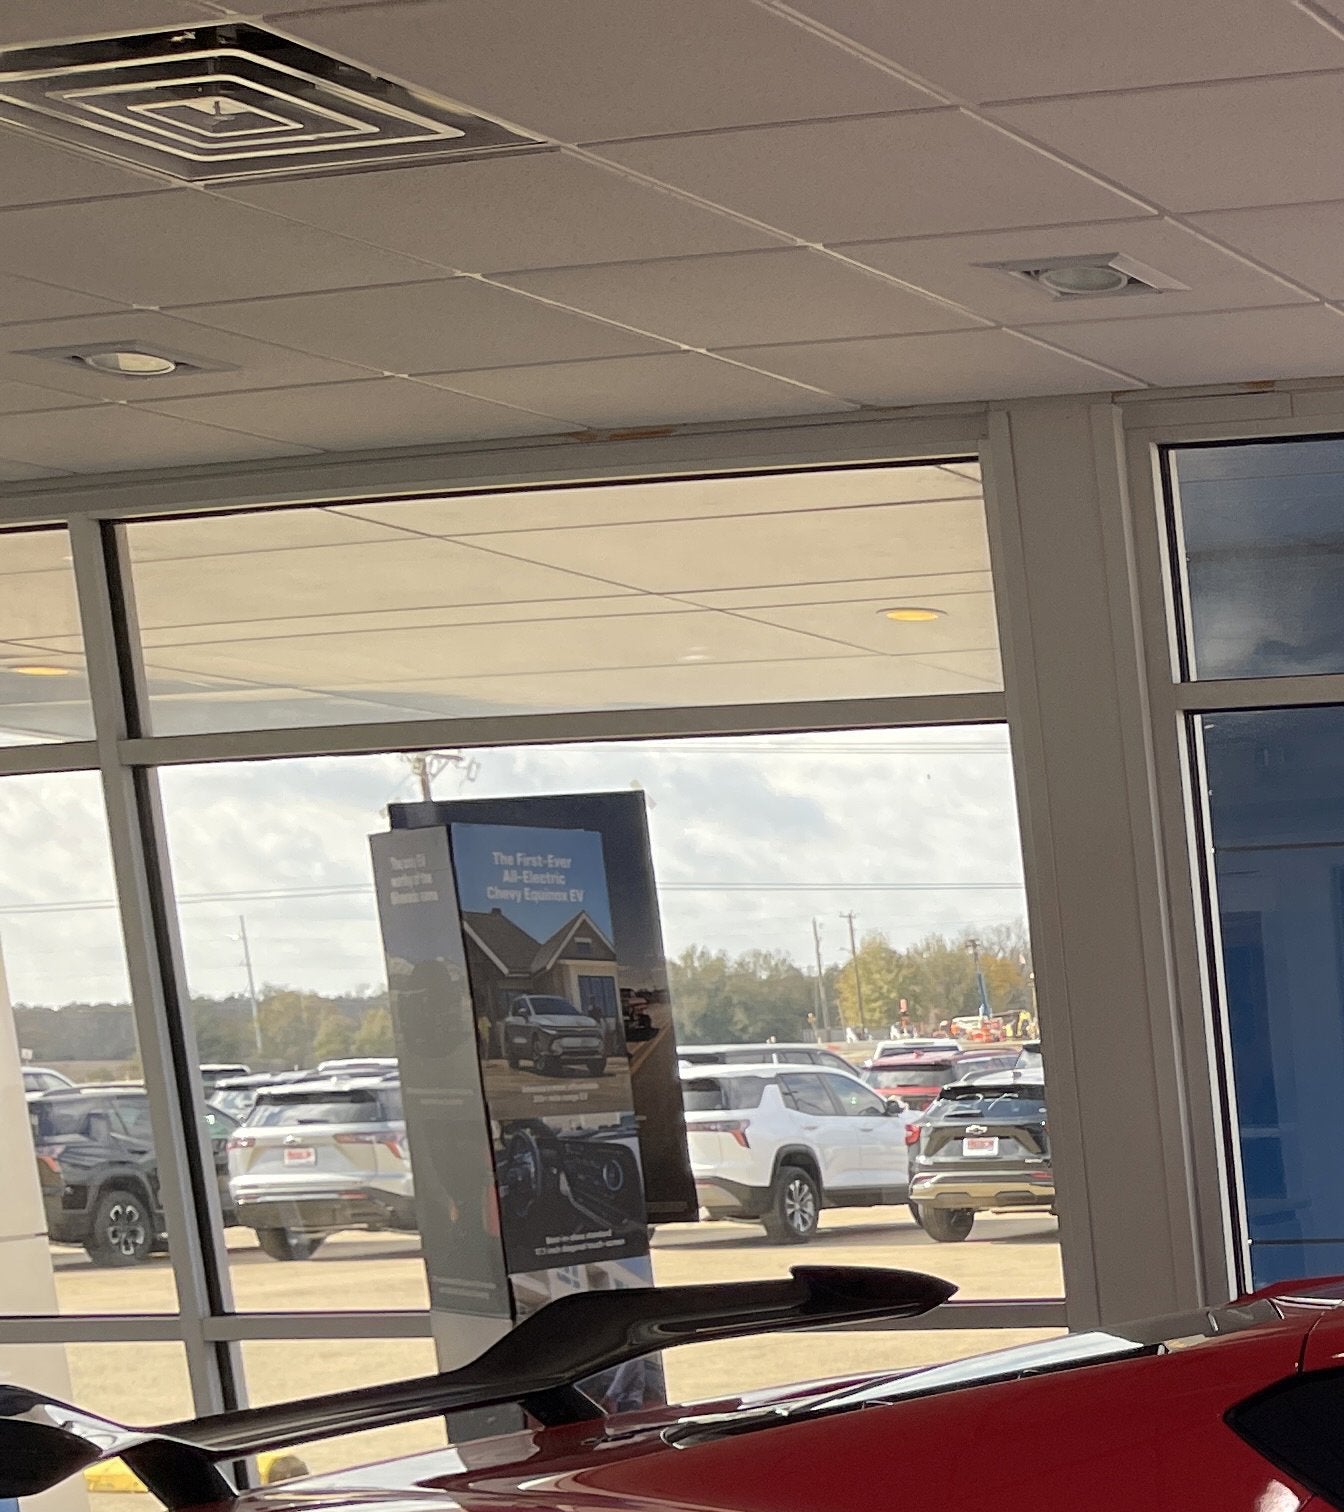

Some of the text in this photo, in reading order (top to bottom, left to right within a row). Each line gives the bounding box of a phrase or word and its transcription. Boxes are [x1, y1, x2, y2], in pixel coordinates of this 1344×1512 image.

[492, 851, 572, 869] The First-Ever
[502, 869, 566, 886] All-Electric
[486, 886, 585, 904] Chevy Equinox EV
